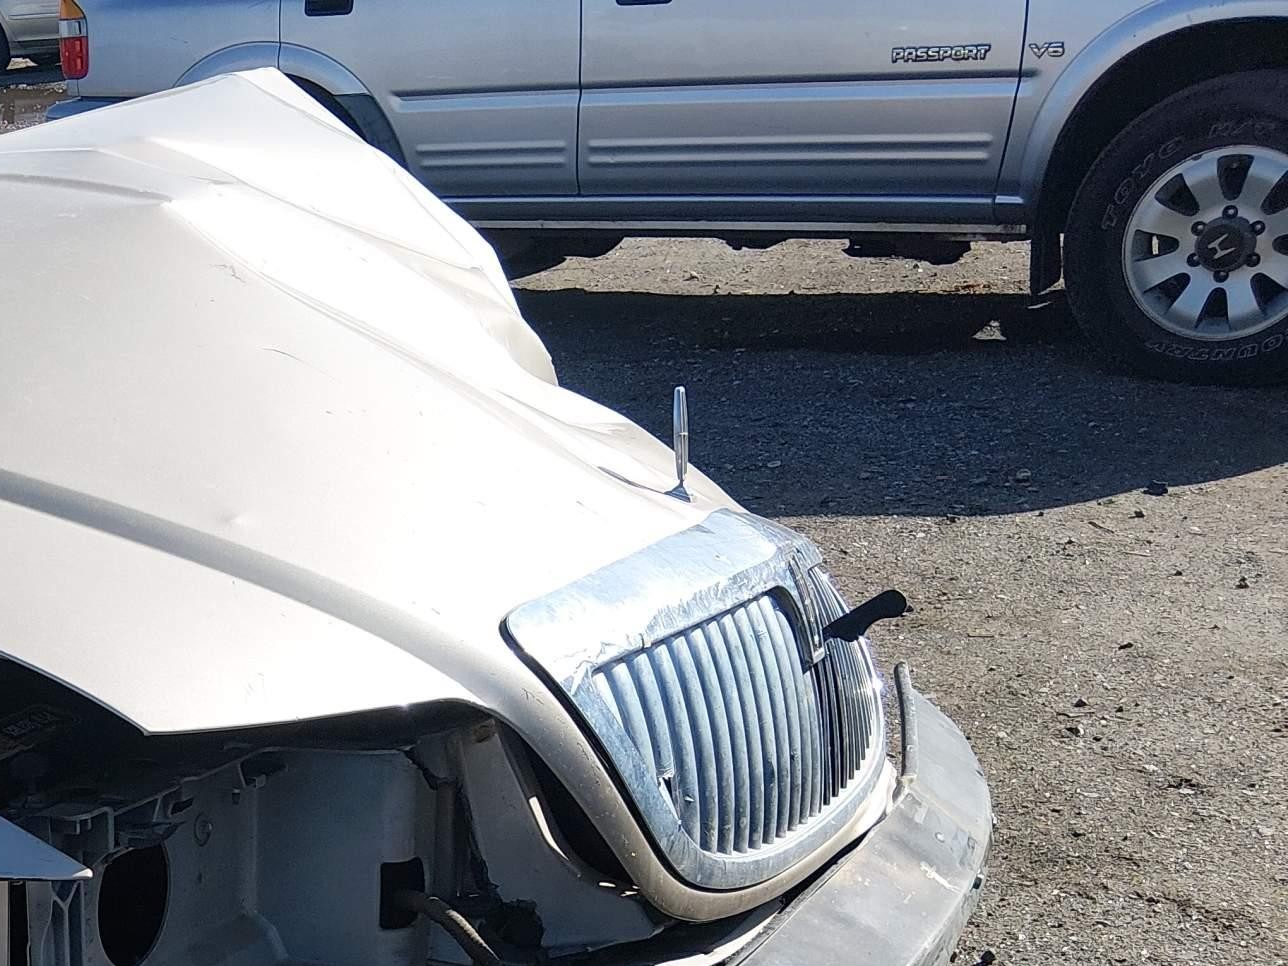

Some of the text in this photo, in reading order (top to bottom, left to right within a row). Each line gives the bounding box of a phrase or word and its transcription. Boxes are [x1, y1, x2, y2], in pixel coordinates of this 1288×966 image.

[891, 41, 1065, 63] PASSPORT V6
[1144, 328, 1288, 360] OUNTRY
